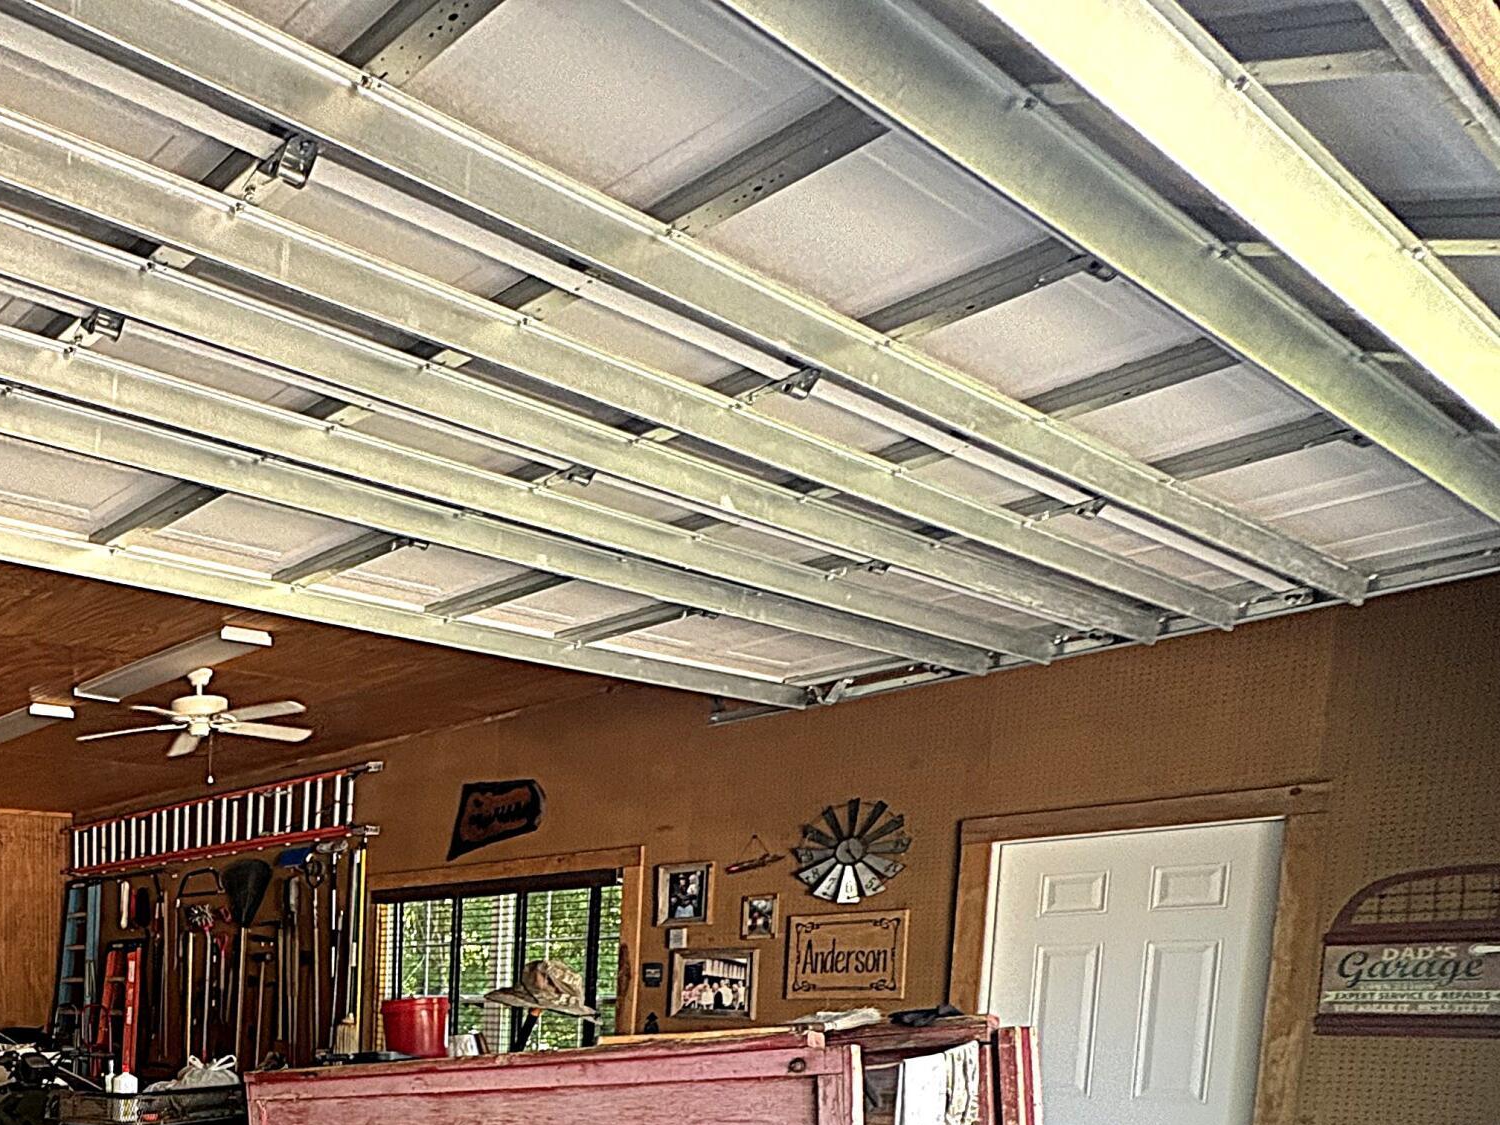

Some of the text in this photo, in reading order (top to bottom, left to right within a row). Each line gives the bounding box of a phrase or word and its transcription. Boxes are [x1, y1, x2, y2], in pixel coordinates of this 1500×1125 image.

[865, 876, 877, 890] 5
[801, 938, 888, 975] Anderson
[1381, 945, 1459, 961] DAD'S
[1337, 950, 1484, 988] Garage
[1334, 991, 1376, 1001] EXPERT
[1379, 991, 1423, 1001] SERVICE
[1441, 991, 1492, 1001] REPAIRS
